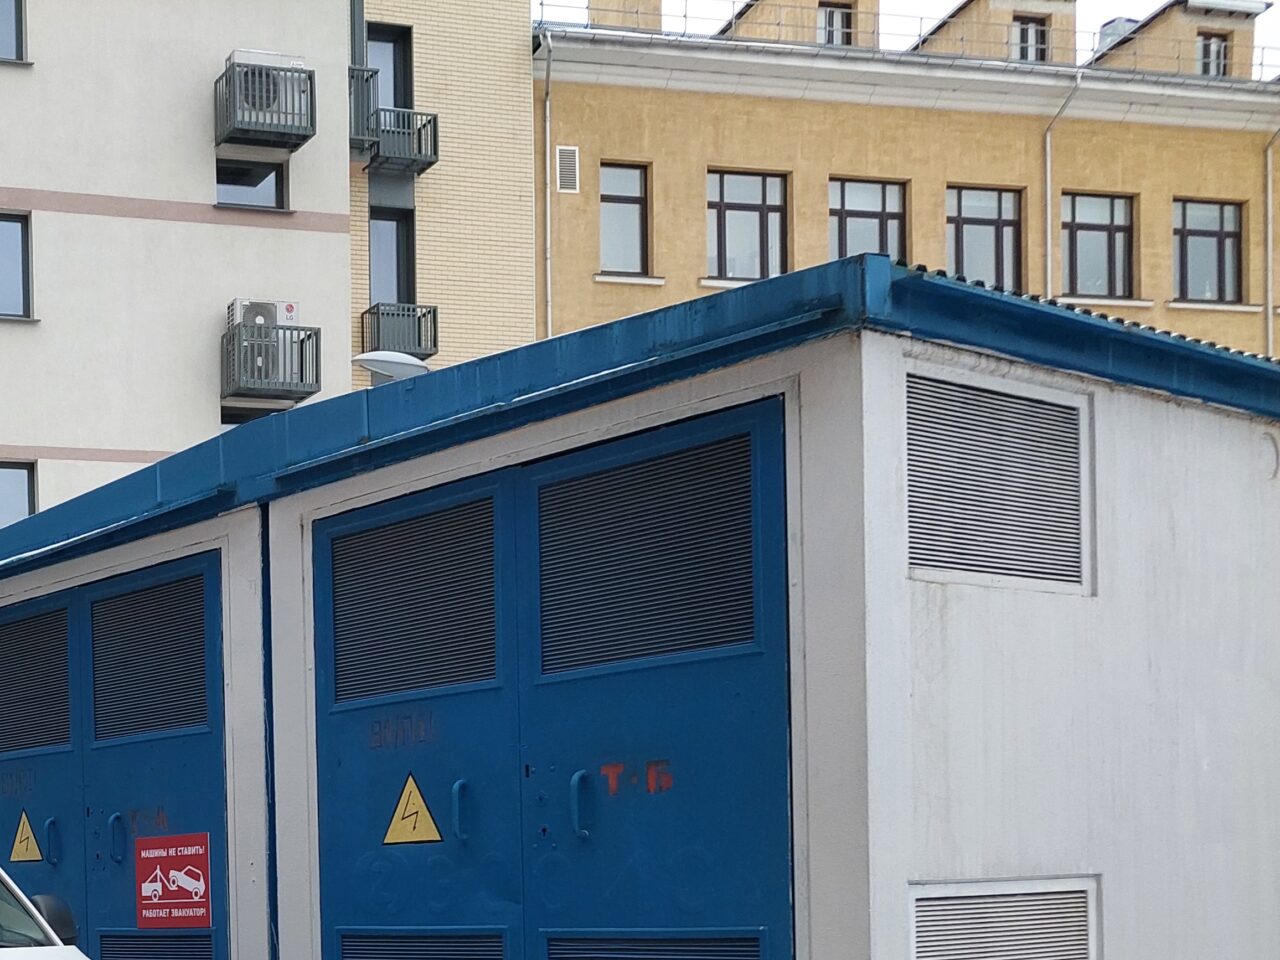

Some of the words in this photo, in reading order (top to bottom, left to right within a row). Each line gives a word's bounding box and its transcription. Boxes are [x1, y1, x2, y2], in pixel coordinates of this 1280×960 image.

[141, 848, 167, 859] МАШИНЫ
[169, 847, 176, 856] НЕ
[177, 845, 205, 856] СТАВИТЬ!
[142, 908, 169, 917] РАБОТАЕТ
[171, 907, 206, 917] ЭВАКУАТОР!
